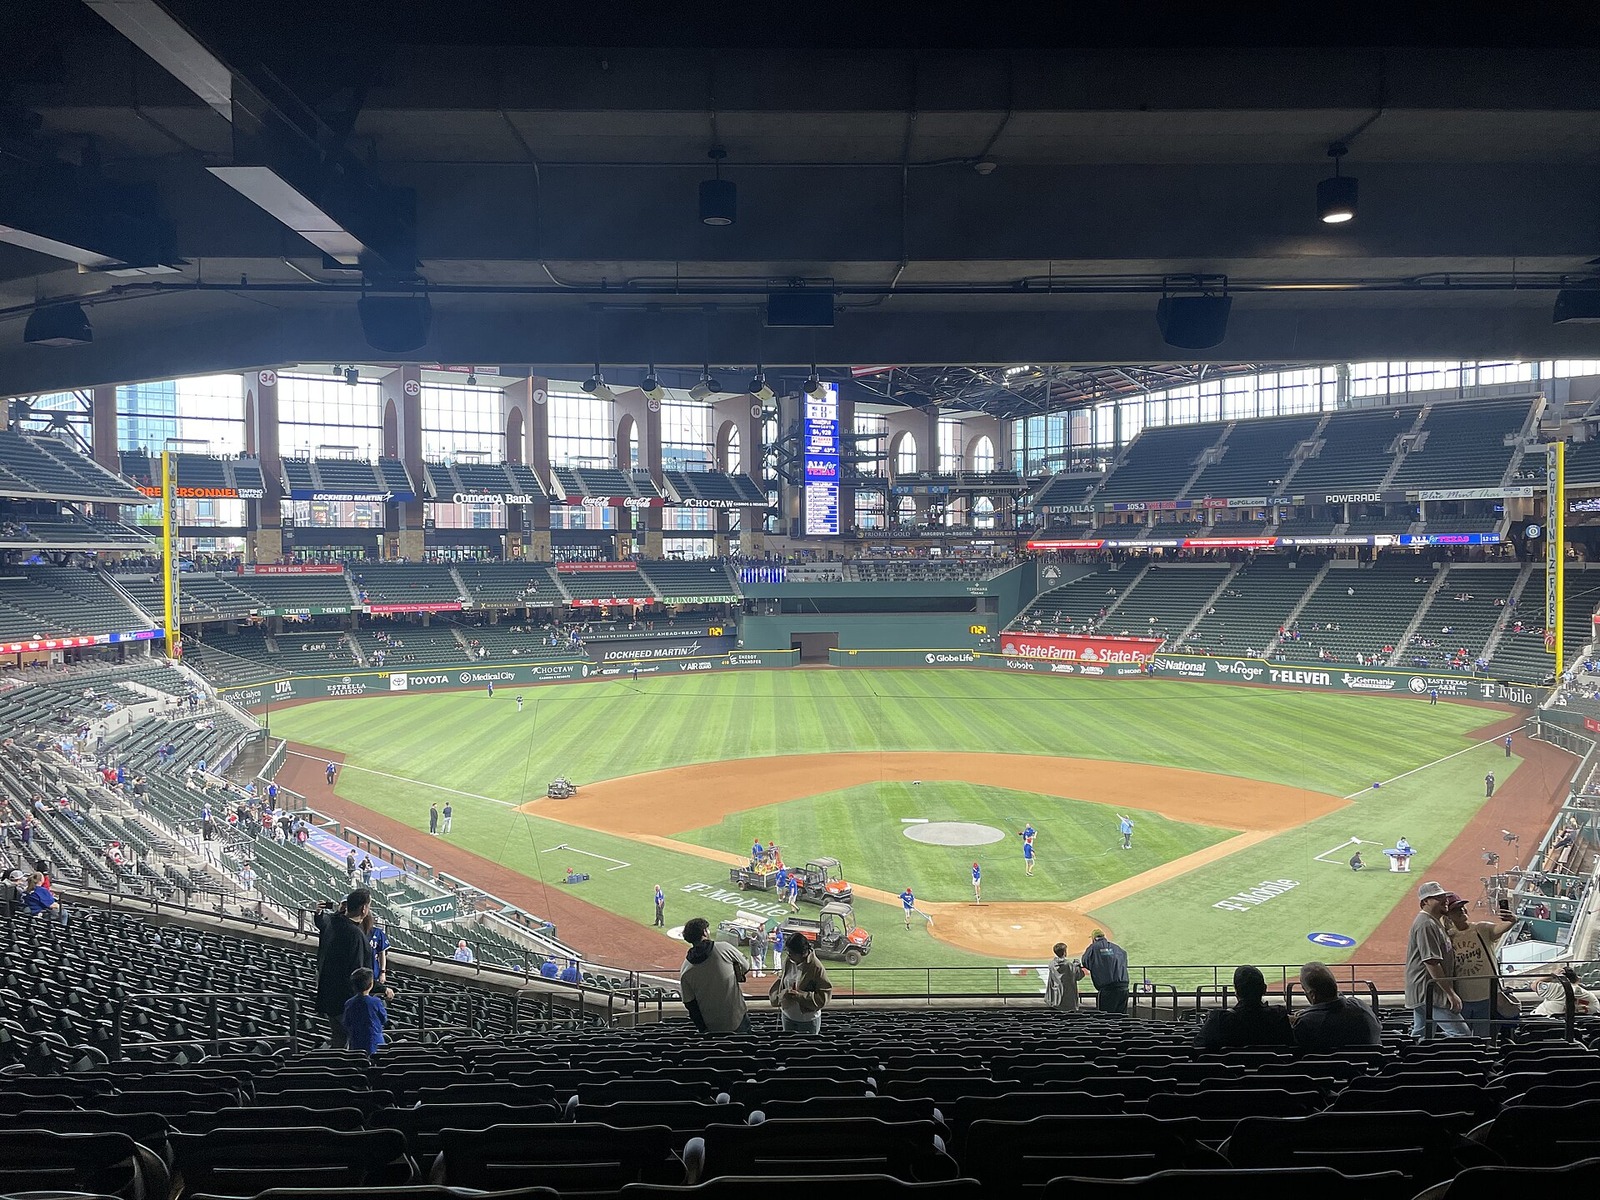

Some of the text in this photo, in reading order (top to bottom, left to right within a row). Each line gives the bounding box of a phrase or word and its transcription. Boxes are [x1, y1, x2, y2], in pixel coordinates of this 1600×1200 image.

[260, 371, 276, 383] 34
[406, 382, 419, 393] 26
[537, 393, 544, 401] 7
[649, 400, 659, 409] 29
[753, 407, 760, 416] 10
[807, 461, 826, 469] ALL
[807, 468, 836, 476] TEXAS
[176, 487, 238, 498] ERSONNEL
[313, 493, 353, 501] LOCKHEED
[1420, 491, 1444, 500] Blue
[1447, 489, 1474, 498] Mint
[505, 493, 533, 504] Bank
[689, 499, 734, 508] CHOCTAW
[1325, 494, 1381, 503] POWERADE
[1050, 504, 1095, 514] UT DALLAS
[1548, 471, 1556, 540] CHIKIN
[1411, 535, 1429, 544] ALL
[1438, 535, 1470, 543] TEXAS
[671, 595, 737, 604] LUXOR STAFFING
[1548, 577, 1556, 626] FARE
[604, 647, 688, 660] LOCKHEED MARTIN
[936, 653, 974, 662] Globe Life
[537, 666, 574, 675] CHOCTAW
[1006, 660, 1034, 671] Kubota
[1165, 660, 1206, 672] National
[1230, 661, 1263, 680] Kroger
[409, 675, 449, 685] TOYOTA
[472, 672, 516, 682] Medical City
[1356, 676, 1396, 686] Germania
[274, 680, 292, 694] UTA
[327, 683, 367, 691] ESTRELLA
[330, 688, 363, 696] JALISCO
[416, 902, 454, 916] TOYOTA
